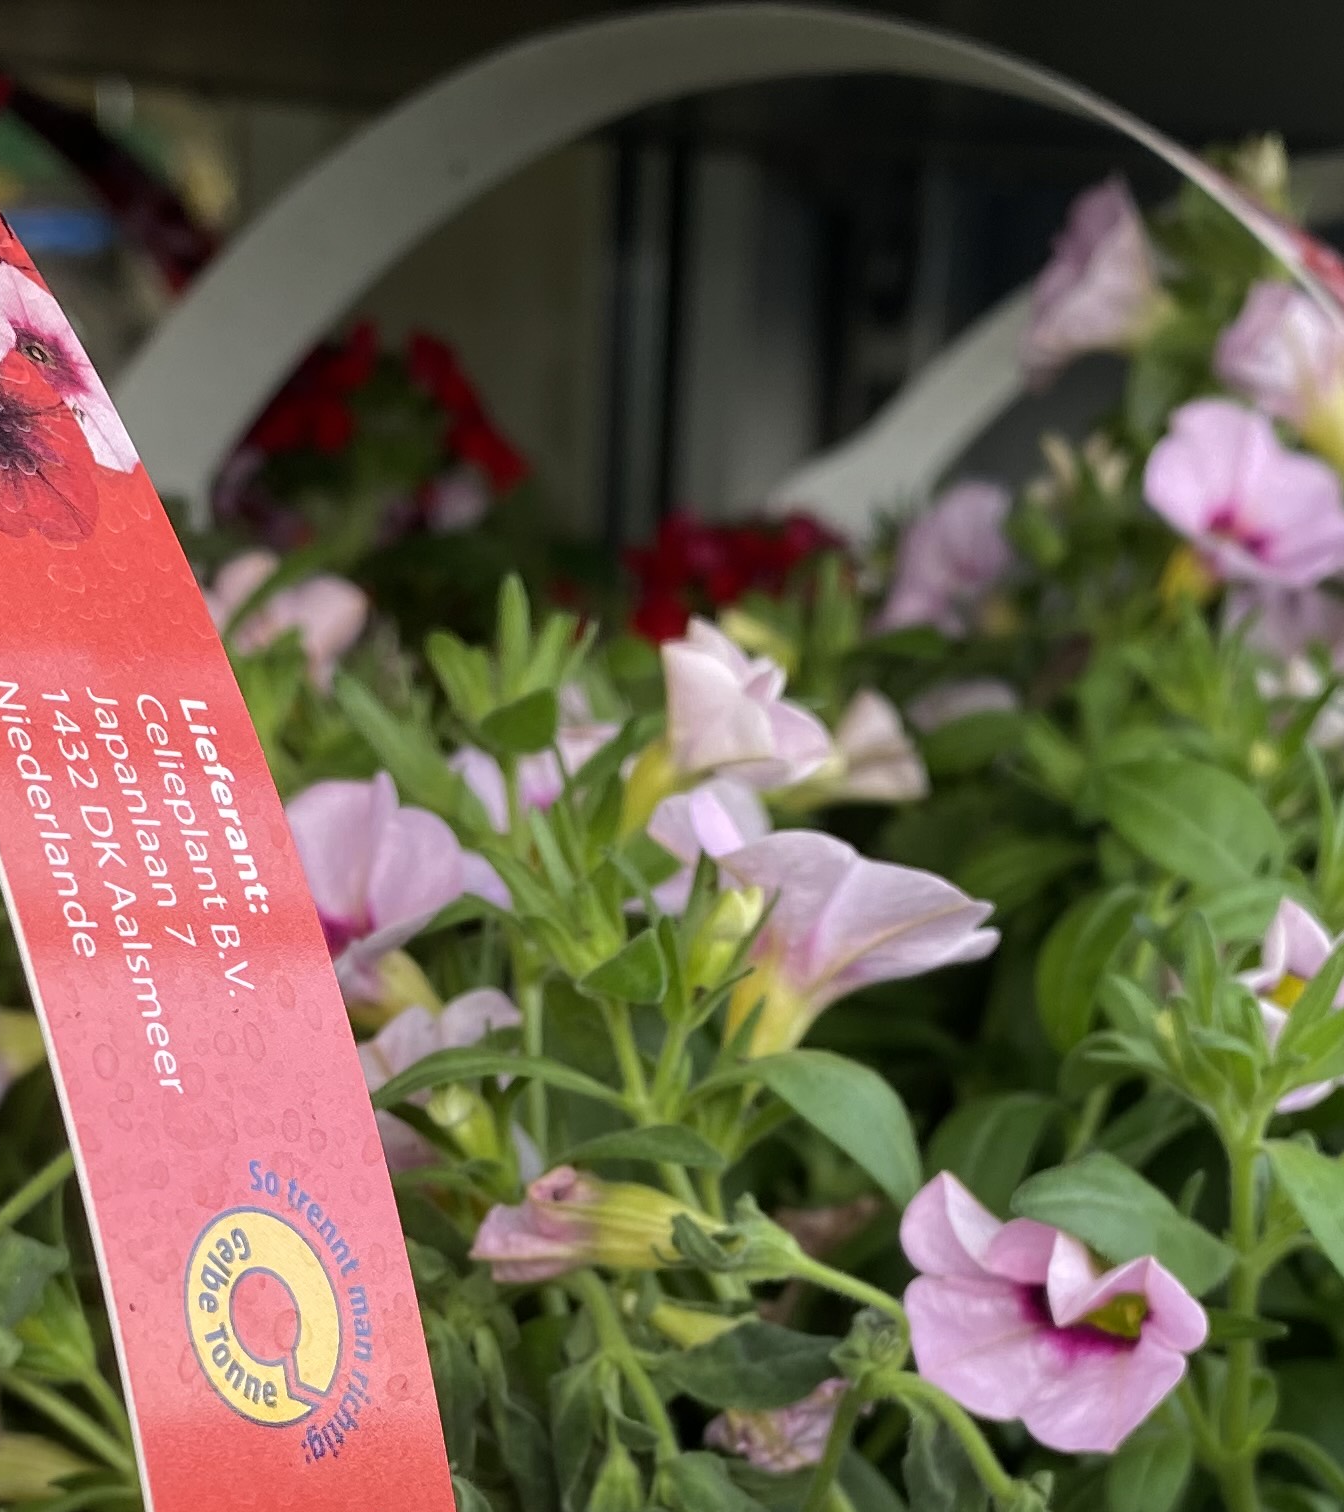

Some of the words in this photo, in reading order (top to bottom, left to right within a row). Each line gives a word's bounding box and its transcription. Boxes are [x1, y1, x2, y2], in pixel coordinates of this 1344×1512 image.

[42, 688, 100, 790] 1432
[79, 805, 127, 869] DK
[103, 880, 185, 1095] Aalsmeer
[86, 687, 177, 907] Japanlaan
[165, 923, 197, 947] 7
[136, 694, 228, 910] Celieplant
[210, 923, 256, 998] B.V.
[179, 698, 270, 914] Lieferant:
[198, 1227, 252, 1314] Gelbe
[204, 1321, 278, 1408] Tonne
[248, 1159, 281, 1198] So
[287, 1178, 360, 1278] trennt
[347, 1284, 373, 1363] man
